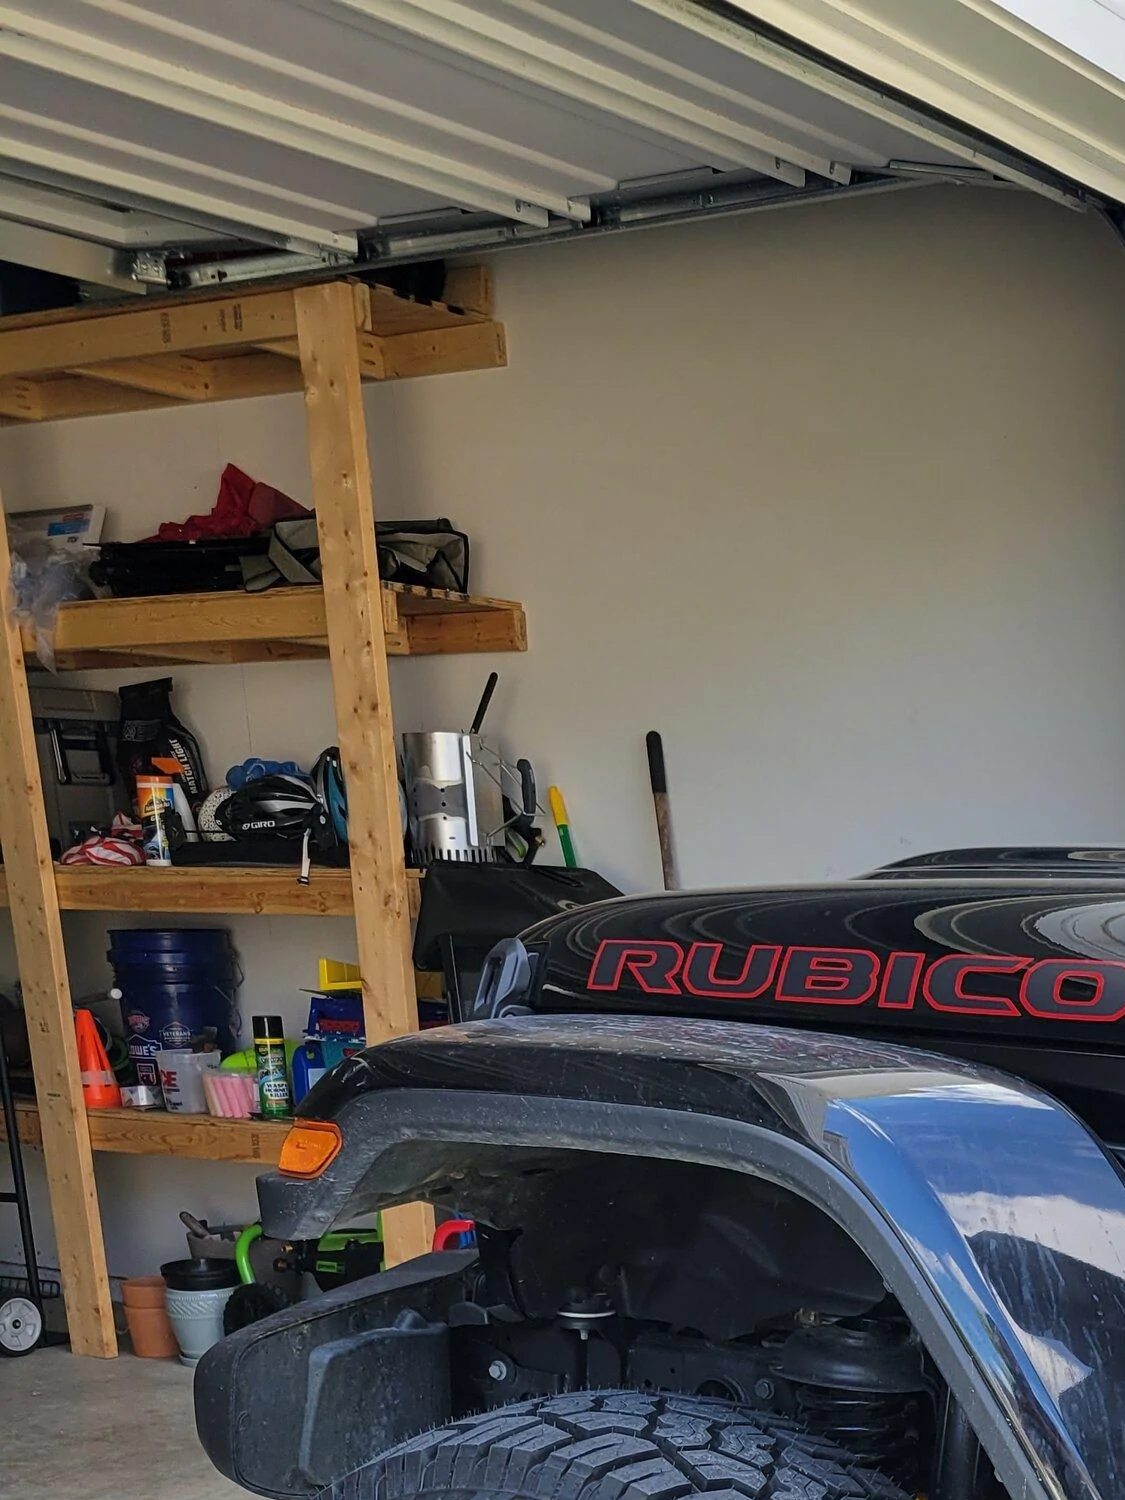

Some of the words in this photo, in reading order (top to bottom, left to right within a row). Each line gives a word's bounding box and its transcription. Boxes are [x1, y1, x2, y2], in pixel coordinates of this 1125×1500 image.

[168, 738, 188, 763] LIGHT
[251, 820, 276, 829] GIRO
[128, 1043, 157, 1057] OWE'S
